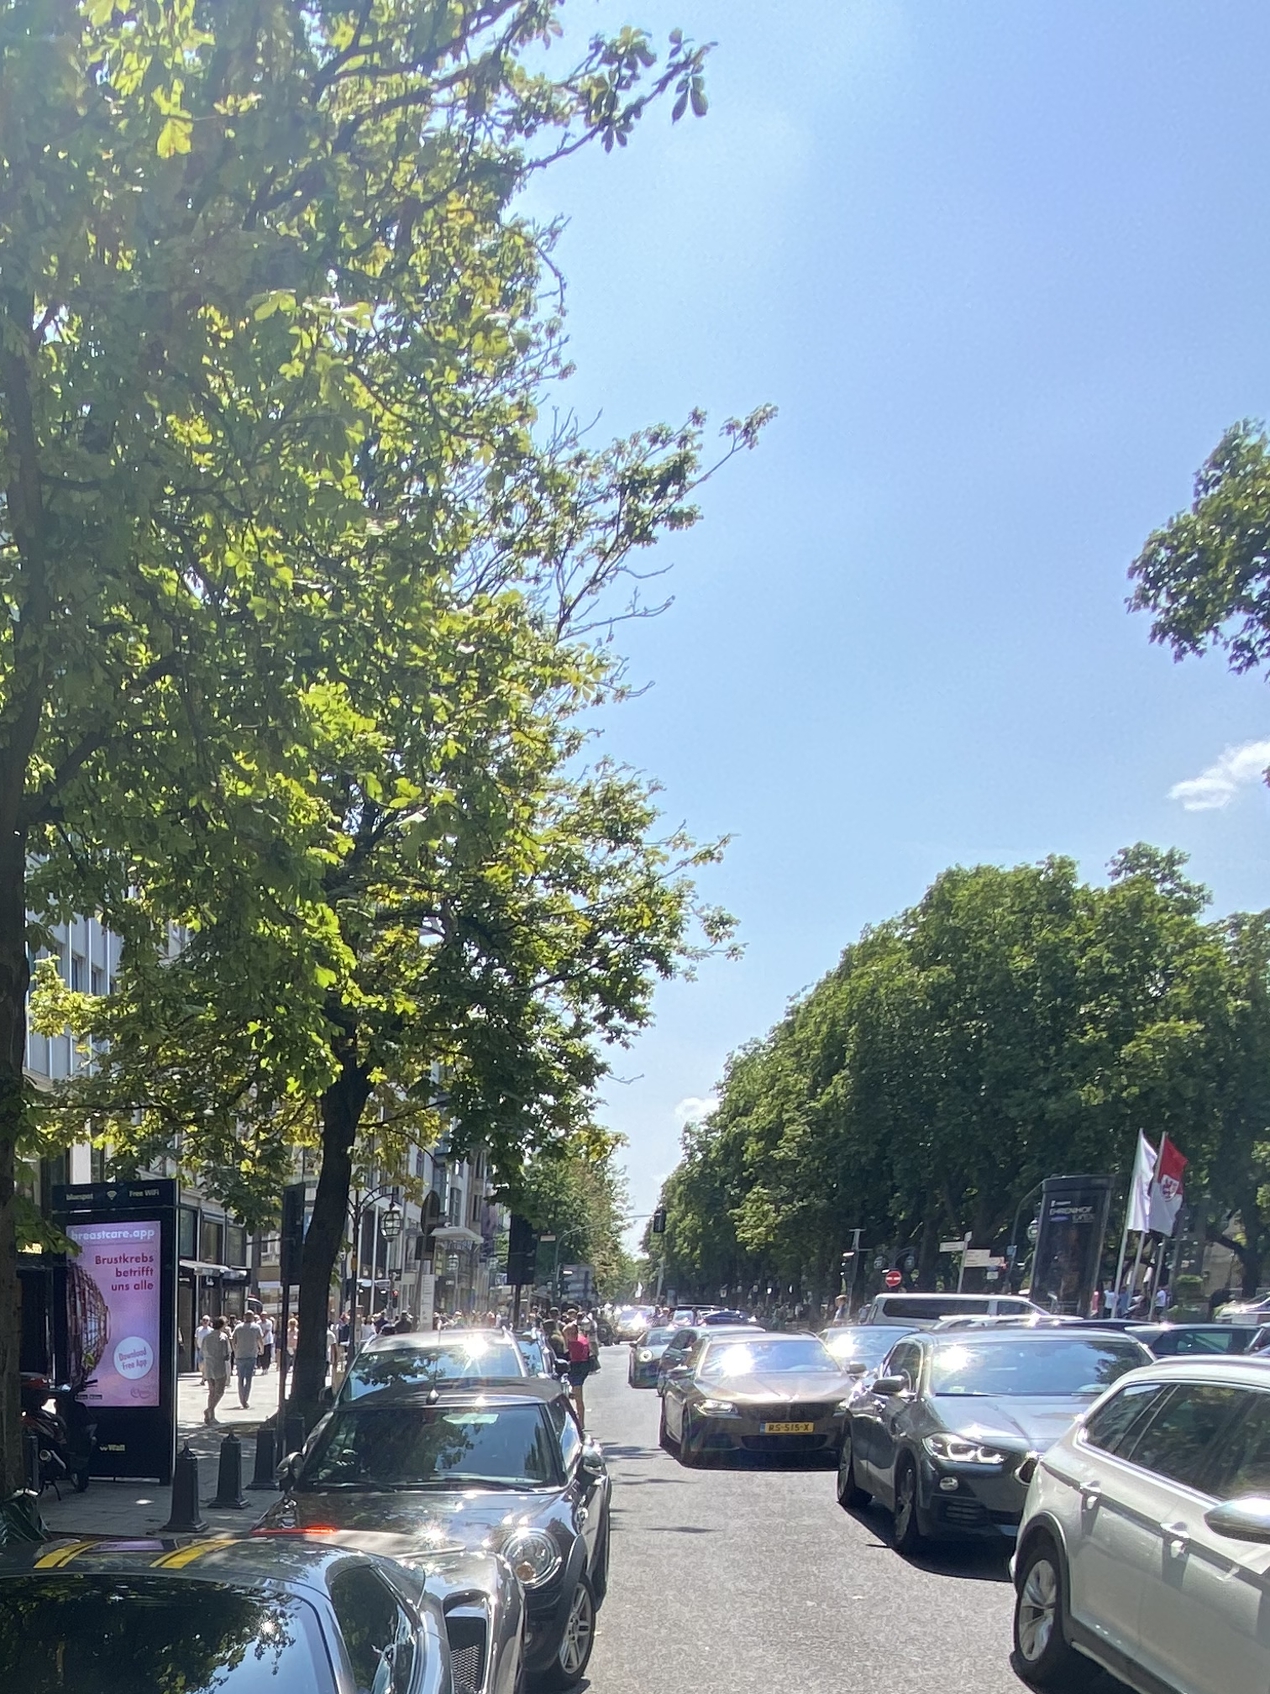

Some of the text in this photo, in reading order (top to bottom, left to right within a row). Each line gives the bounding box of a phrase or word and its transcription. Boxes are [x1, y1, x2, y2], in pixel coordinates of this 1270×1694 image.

[71, 1229, 155, 1241] breastcare.app
[95, 1253, 154, 1265] Brustkrebs
[116, 1266, 154, 1278] betrifft
[111, 1280, 154, 1292] uns alle
[119, 1346, 147, 1361] Download
[123, 1359, 147, 1370] Free App
